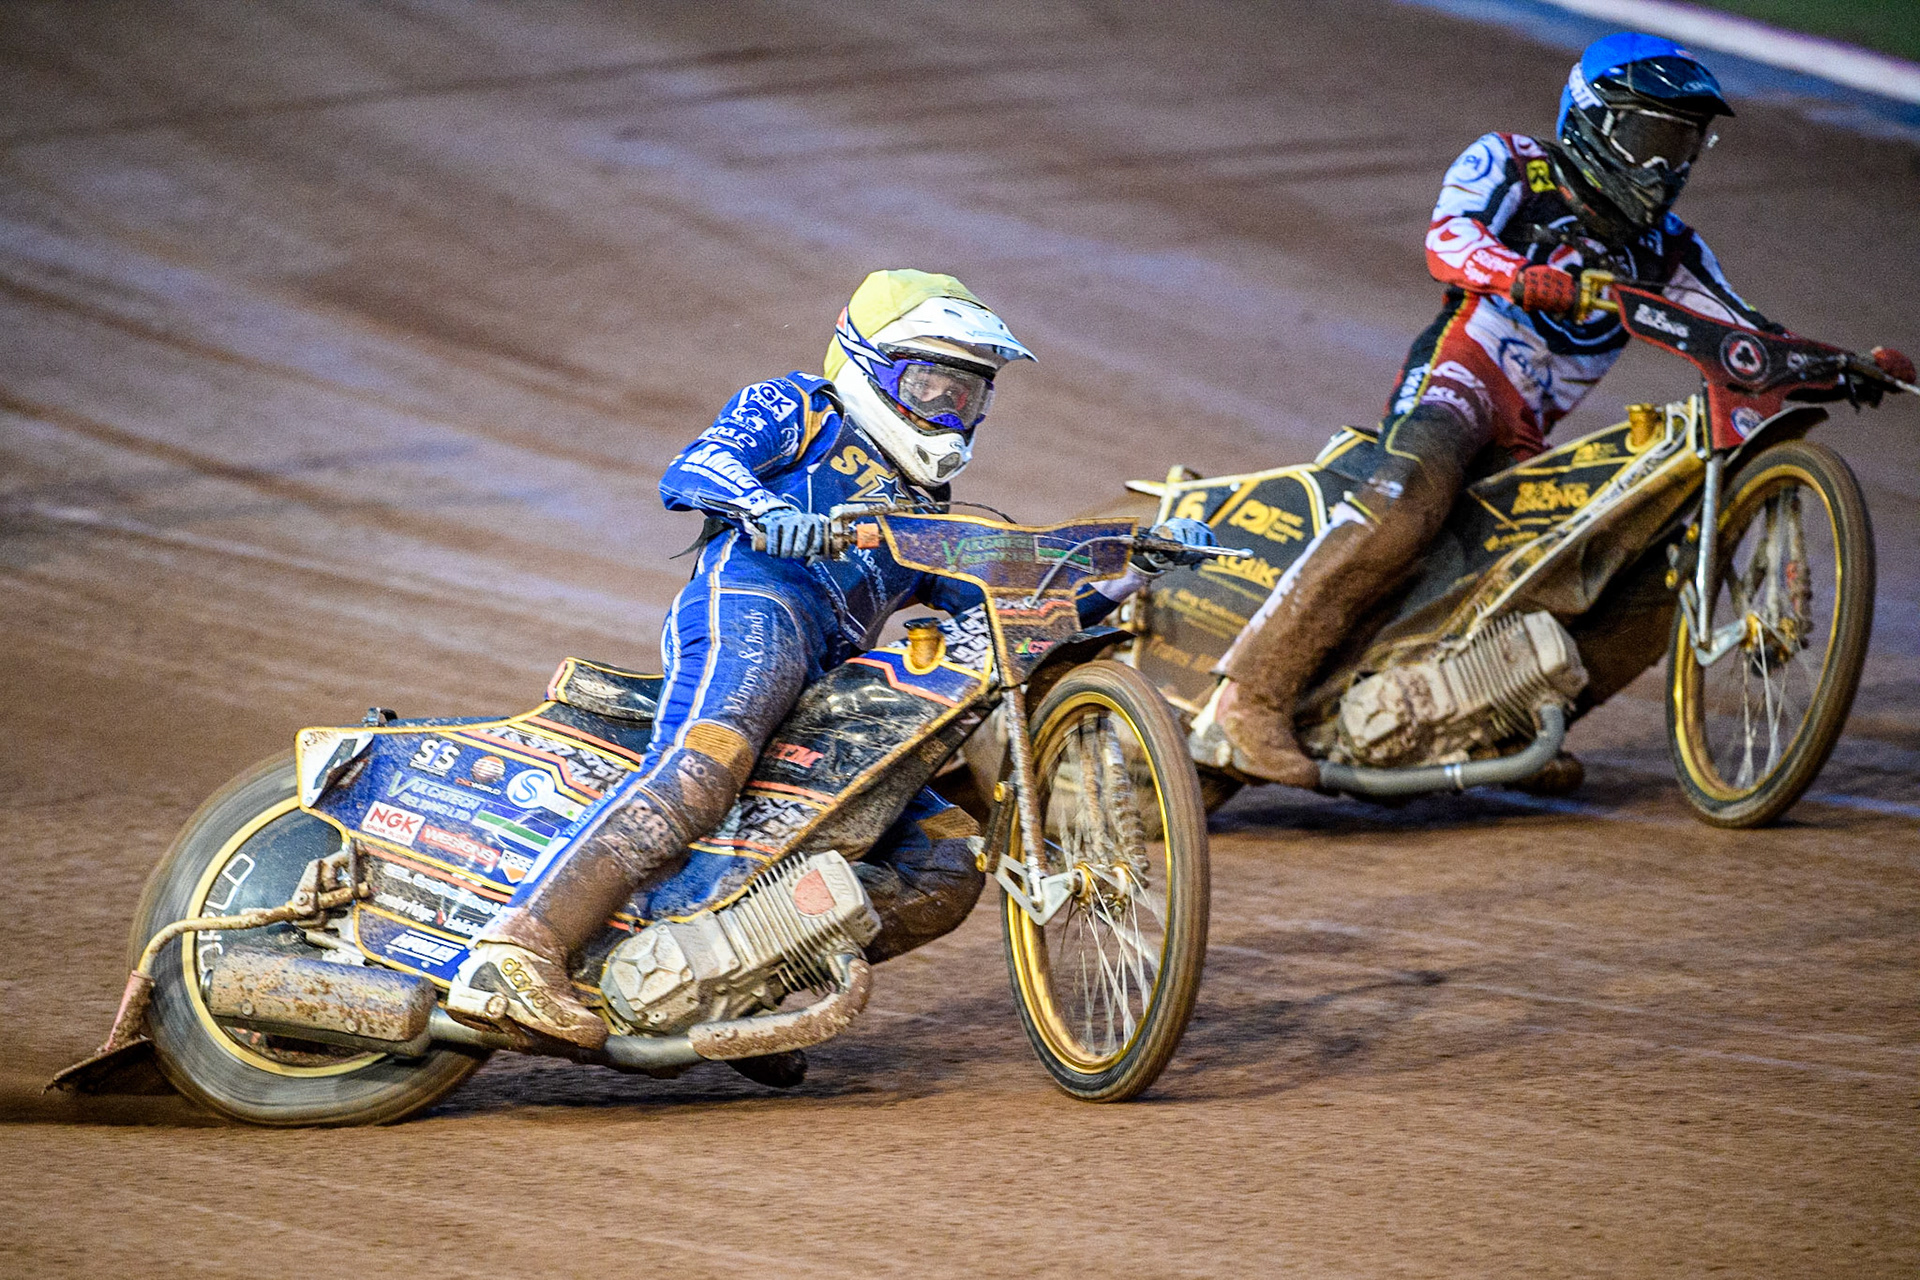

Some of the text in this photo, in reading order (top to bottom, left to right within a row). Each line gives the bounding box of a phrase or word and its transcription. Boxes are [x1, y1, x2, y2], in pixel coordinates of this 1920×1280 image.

[723, 609, 769, 713] Minors & Brady
[369, 807, 420, 835] NGK
